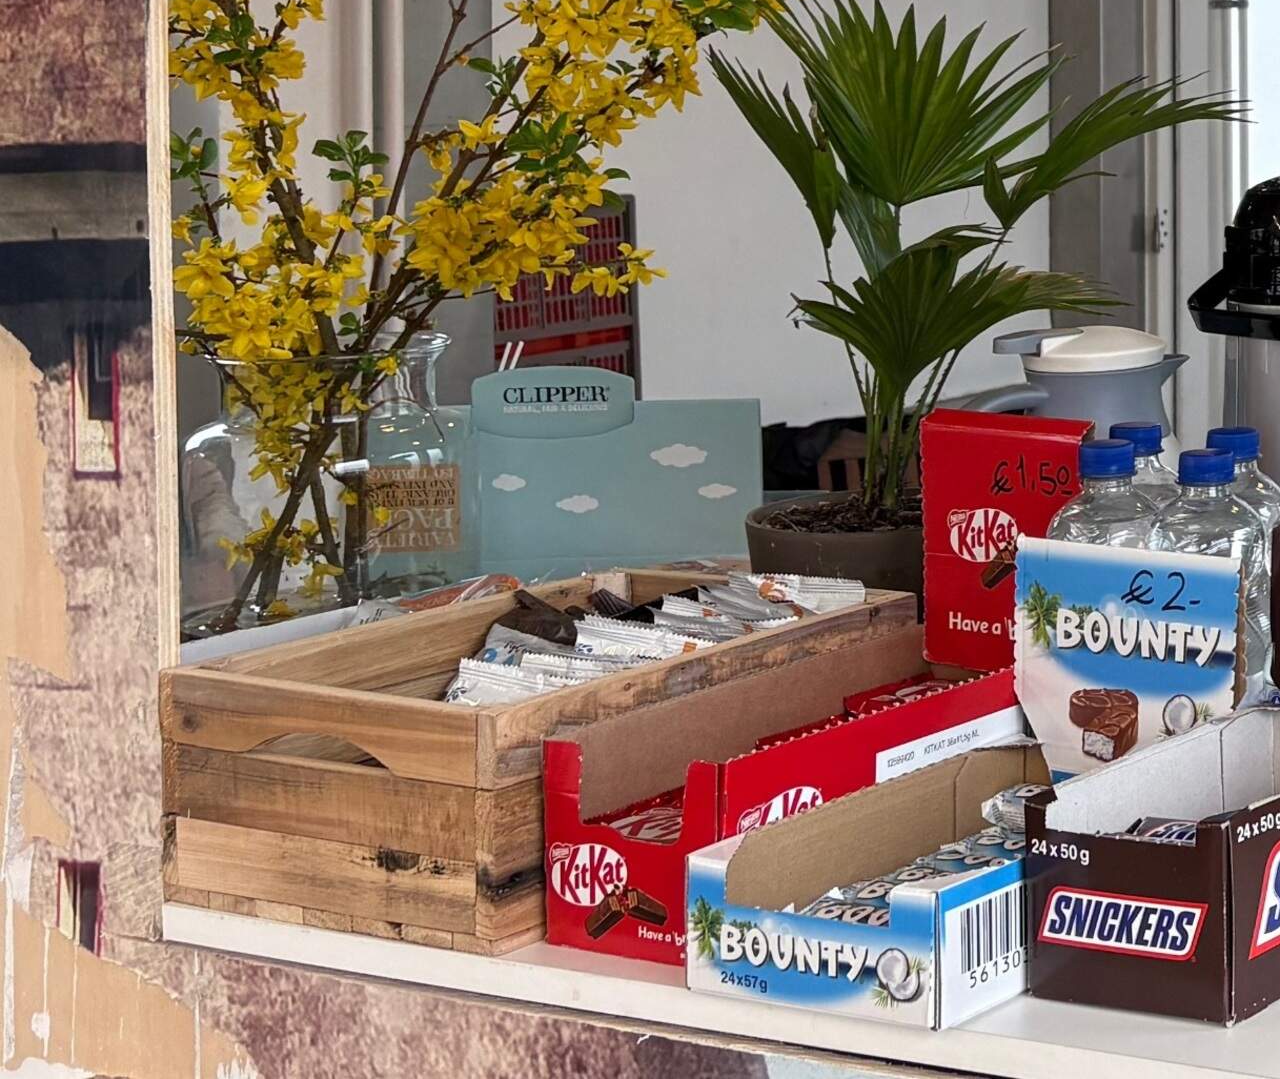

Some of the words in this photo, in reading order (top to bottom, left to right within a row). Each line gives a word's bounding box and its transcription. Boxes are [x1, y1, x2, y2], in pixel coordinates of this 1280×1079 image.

[503, 385, 608, 404] CLIPPER
[957, 509, 1014, 560] KitKat
[949, 611, 988, 634] Have
[992, 623, 1001, 635] a
[1056, 608, 1221, 667] BOUNTY
[1031, 838, 1048, 855] 24
[560, 845, 625, 904] KitKat
[638, 925, 664, 941] Have
[665, 933, 672, 942] a
[1047, 894, 1197, 952] SNICKERS
[720, 923, 868, 983] BOUNTY
[720, 970, 768, 994] 24x57g
